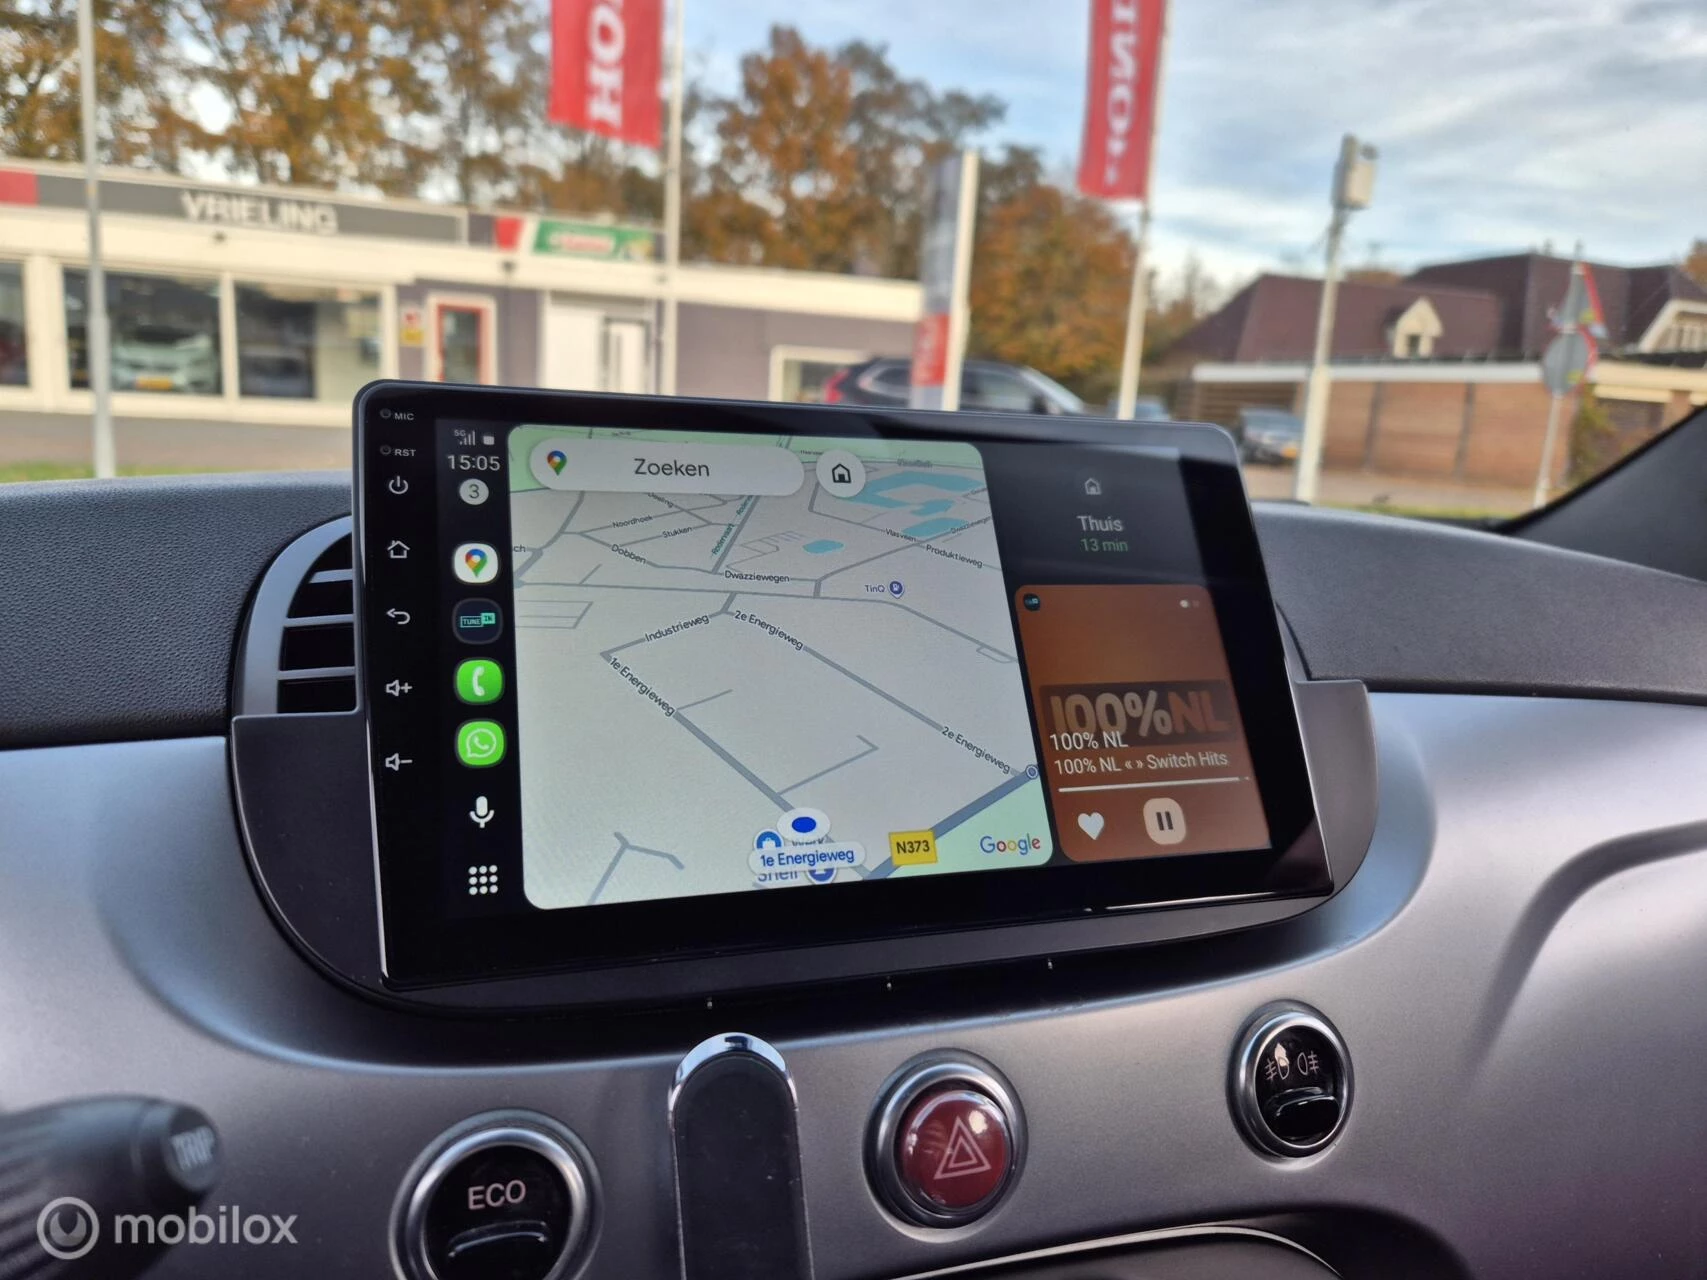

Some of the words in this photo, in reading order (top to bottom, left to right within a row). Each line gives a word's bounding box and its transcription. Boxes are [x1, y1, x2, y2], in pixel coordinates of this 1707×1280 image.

[588, 0, 625, 128] HO
[180, 189, 339, 235] VRIELING
[394, 412, 415, 421] MIC
[394, 448, 416, 457] RST
[447, 454, 501, 471] 15:05
[633, 457, 710, 478] Zoeken
[468, 483, 480, 499] 3
[662, 526, 693, 539] Stukken
[1077, 515, 1124, 532] Thuis
[611, 543, 647, 565] Dobben
[926, 543, 983, 569] Produktieweg
[1081, 538, 1099, 552] 13
[1102, 538, 1128, 553] min
[724, 570, 790, 584] Dwazziewegen
[645, 614, 710, 643] Industrieweg
[735, 609, 748, 621] 2e
[748, 613, 804, 651] Energieweg
[610, 657, 621, 670] 1e
[620, 665, 676, 717] Energieweg
[942, 726, 955, 739] 2e
[955, 733, 1011, 775] Energieweg
[1050, 731, 1099, 751] 100%
[1103, 731, 1129, 749] NL
[1055, 758, 1097, 775] 100%
[1099, 756, 1122, 772] NL
[1146, 752, 1197, 770] Switch
[1199, 752, 1229, 766] Hits
[895, 840, 930, 855] N373
[979, 833, 1041, 856] Google
[760, 855, 775, 868] 1e
[778, 850, 855, 867] Energieweg
[467, 1180, 526, 1210] ECO
